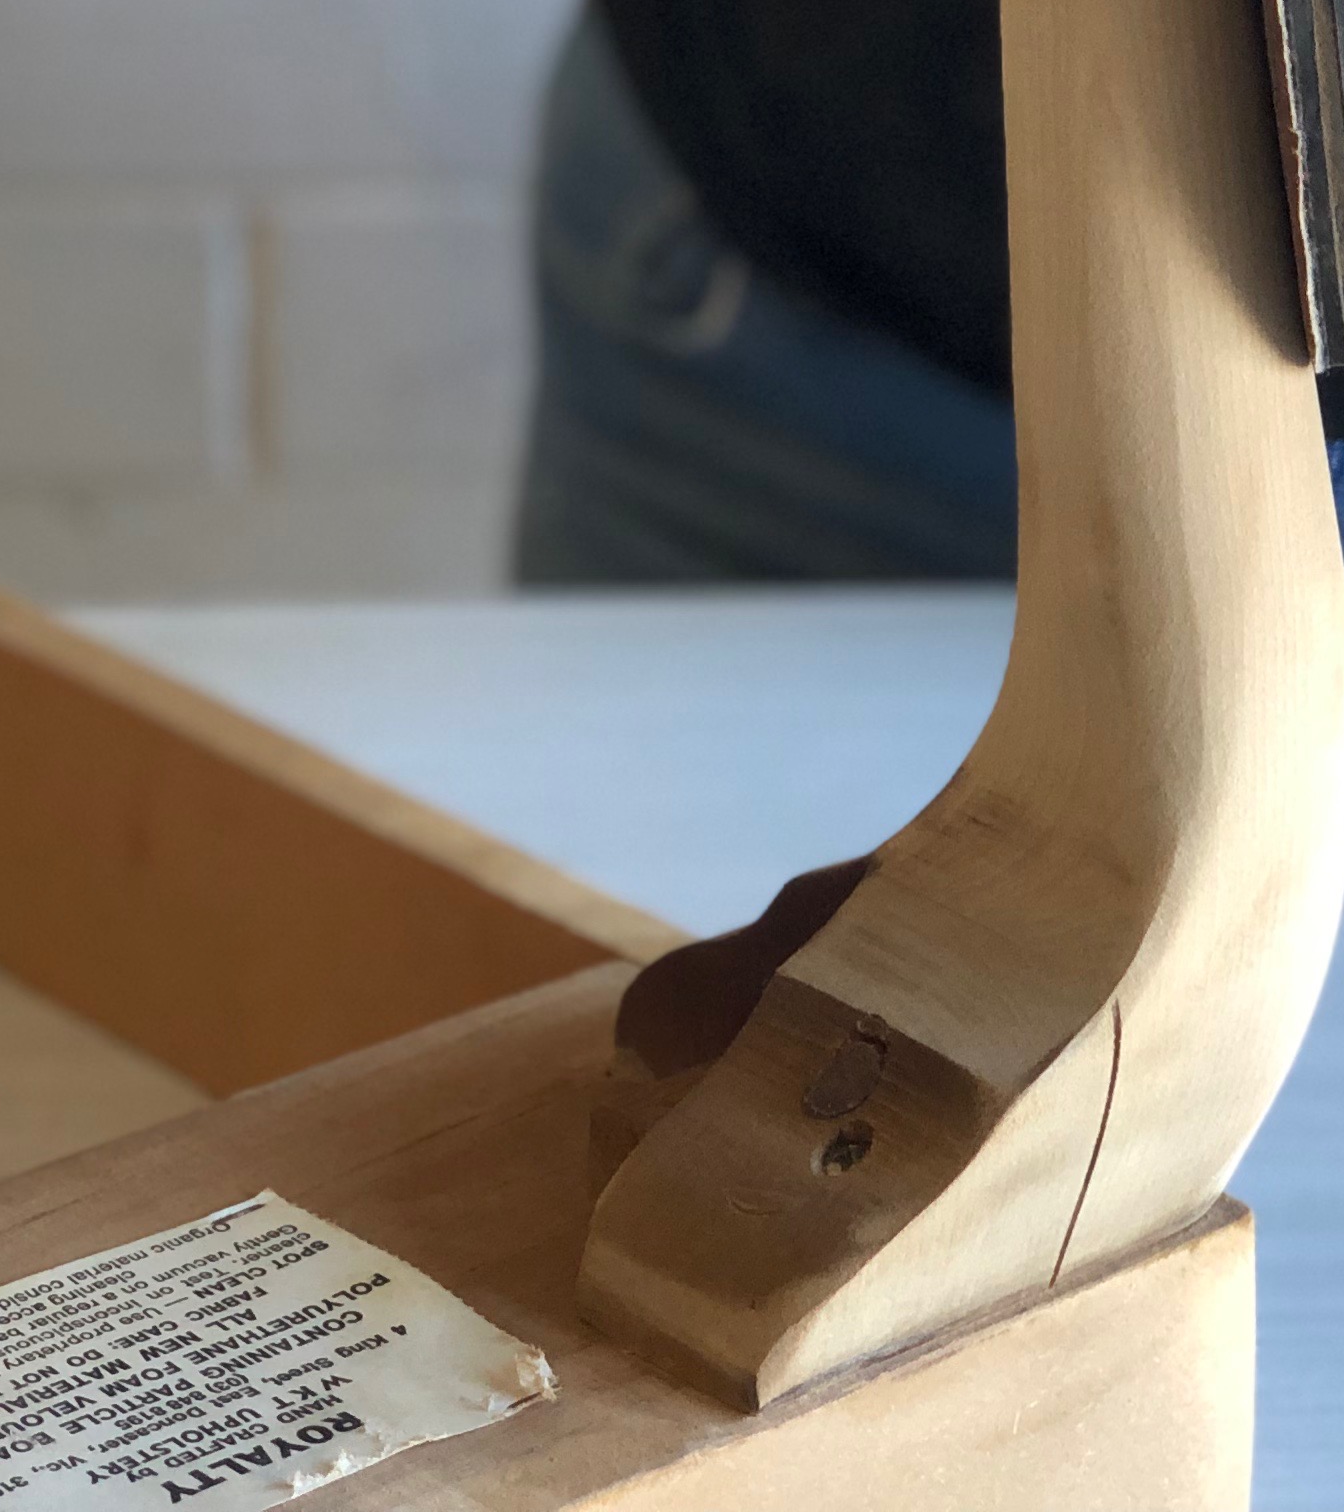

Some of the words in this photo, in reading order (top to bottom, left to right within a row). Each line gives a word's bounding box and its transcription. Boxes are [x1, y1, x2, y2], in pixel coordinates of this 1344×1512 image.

[149, 1221, 231, 1253] Organic
[231, 1231, 311, 1265] cleaner.
[232, 1223, 298, 1253] Gently
[66, 1249, 149, 1285] material
[151, 1250, 231, 1282] vacuum
[271, 1239, 329, 1270] SPOT
[46, 1269, 136, 1305] cleaning
[119, 1280, 149, 1294] on
[145, 1286, 174, 1299] on
[179, 1267, 230, 1287] Test
[191, 1266, 267, 1299] CLEAN
[27, 1298, 100, 1330] regular
[118, 1306, 163, 1325] Use
[169, 1272, 391, 1365] POLYURETHANE
[184, 1285, 268, 1321] FABRIC
[107, 1320, 178, 1349] CARE:
[204, 1307, 257, 1331] ALL
[389, 1324, 407, 1336] 4
[2, 1320, 116, 1370] proprietary
[65, 1348, 104, 1367] DO
[138, 1330, 203, 1362] NEW
[198, 1310, 363, 1379] CONTAINING
[333, 1333, 389, 1358] King
[9, 1365, 60, 1390] NOT
[97, 1360, 182, 1397] FOAM
[204, 1372, 249, 1394] (03)
[260, 1357, 334, 1386] Street,
[58, 1377, 195, 1434] PARTICLE
[165, 1390, 207, 1410] 848
[207, 1385, 261, 1408] East
[275, 1393, 343, 1423] HAND
[87, 1405, 207, 1453] Doncaster,
[113, 1405, 167, 1430] 8195
[85, 1407, 262, 1484] UPHOLSTERY
[160, 1410, 364, 1504] ROYALTY
[163, 1422, 269, 1468] CRAFTED
[125, 1466, 158, 1483] by
